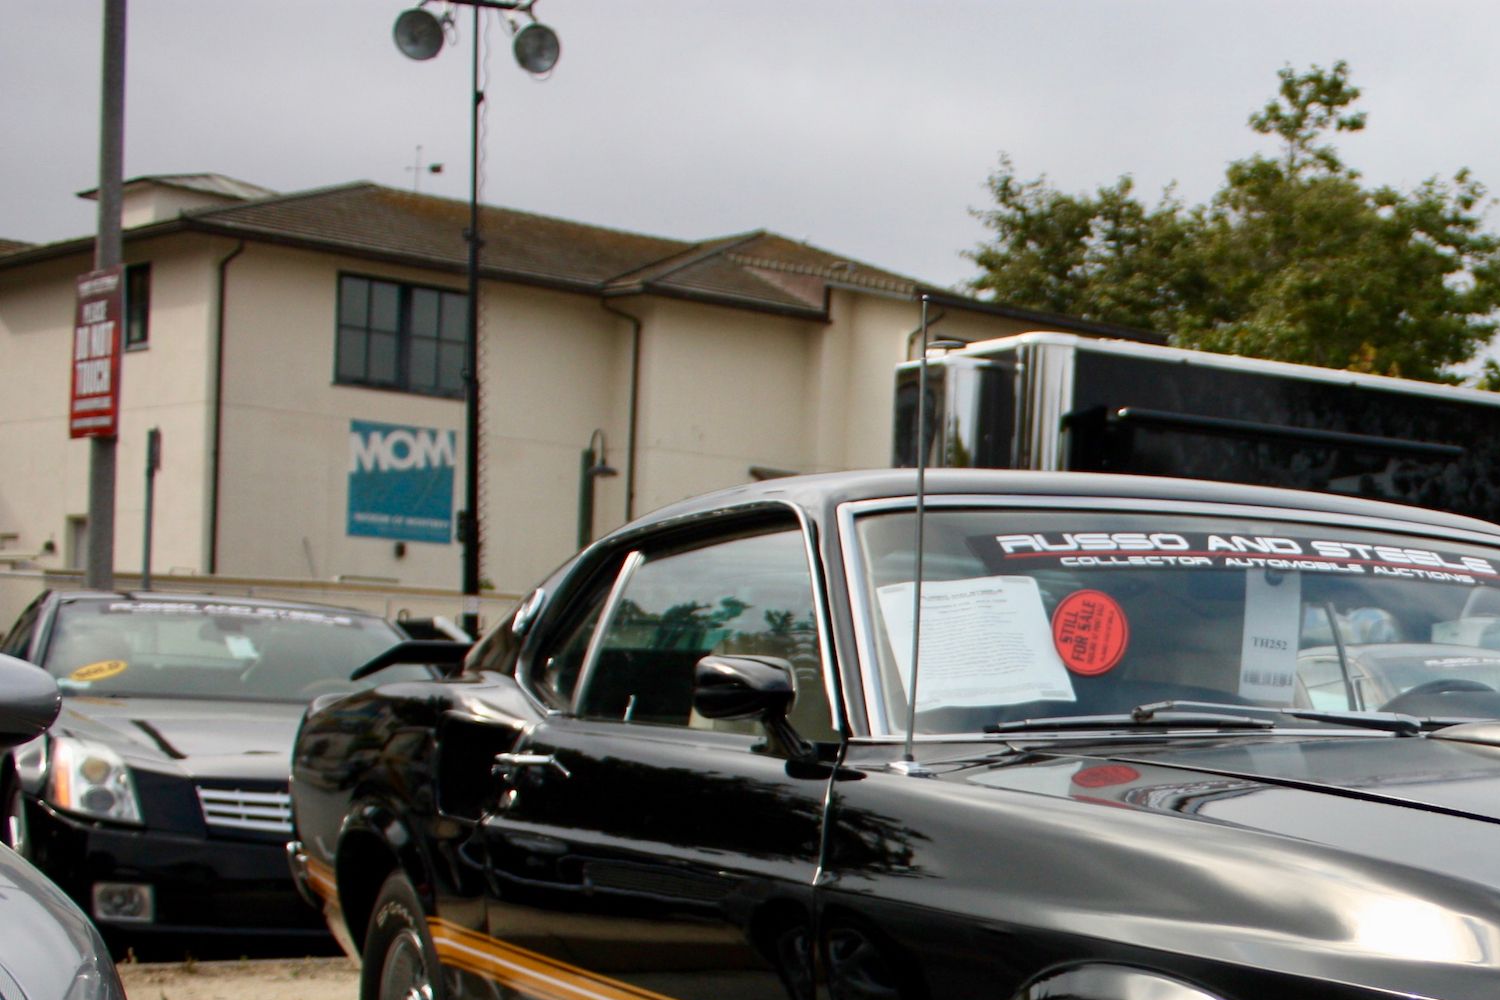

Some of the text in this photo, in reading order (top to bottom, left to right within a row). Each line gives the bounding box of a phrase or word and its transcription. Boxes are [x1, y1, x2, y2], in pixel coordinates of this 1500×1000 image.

[350, 430, 457, 473] MOM
[996, 533, 1498, 575] RUSSO AND STEELE
[1060, 556, 1476, 584] COLLECTOR AUTOMOBILE AUCTIONS
[1060, 611, 1079, 644] STILL
[1078, 599, 1097, 631] SALE
[1071, 635, 1089, 662] FOR
[1252, 636, 1288, 650] TH252
